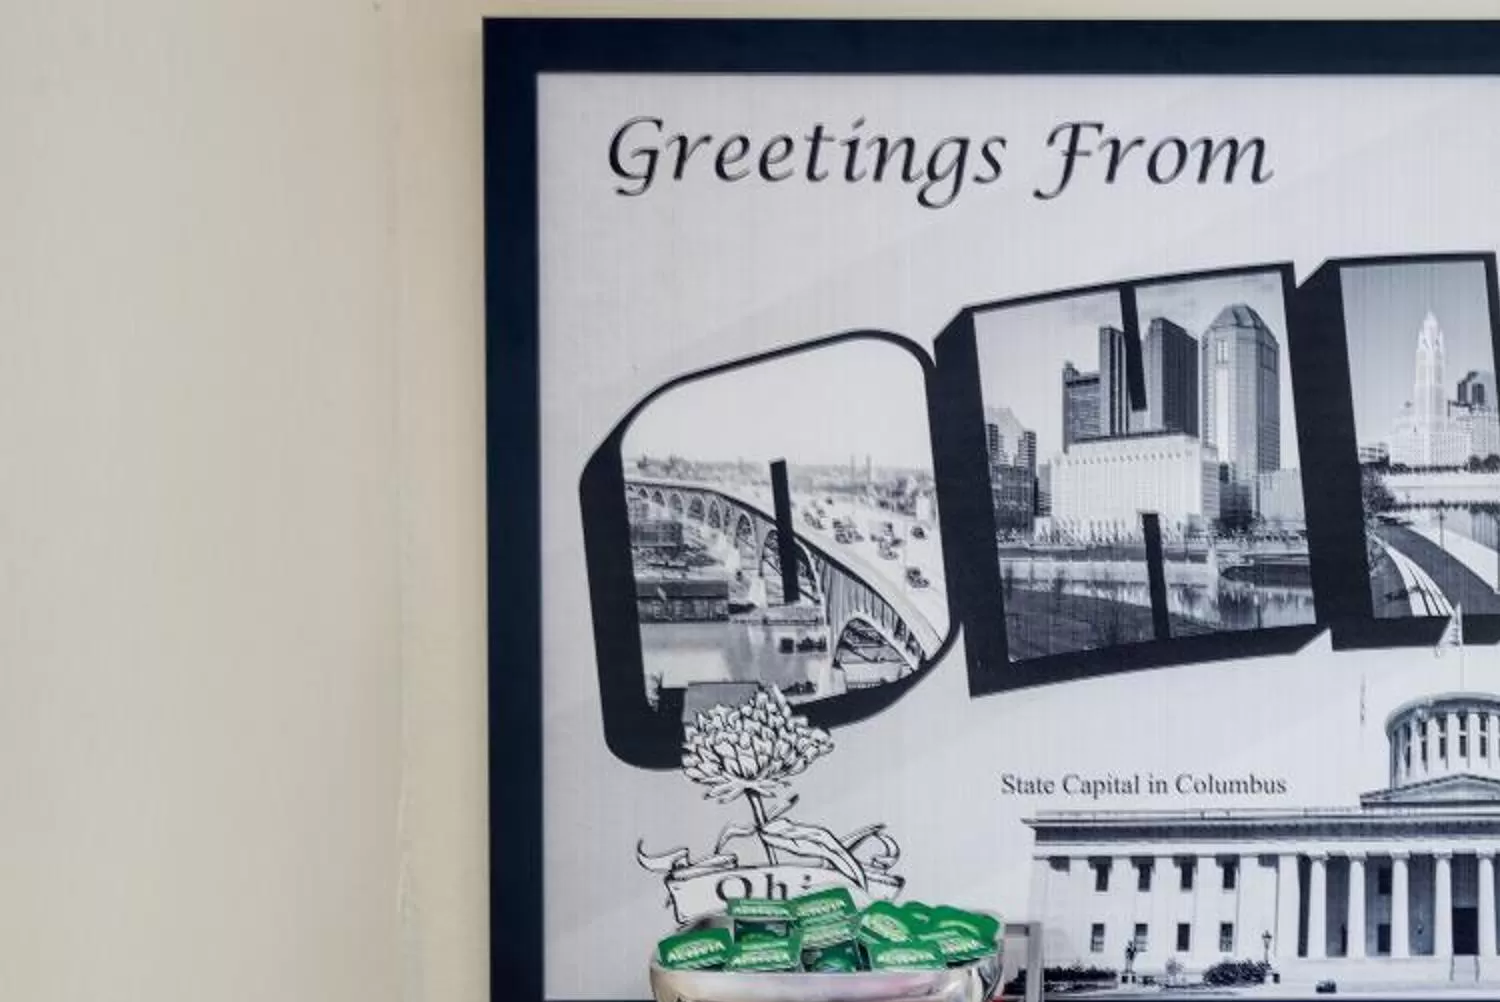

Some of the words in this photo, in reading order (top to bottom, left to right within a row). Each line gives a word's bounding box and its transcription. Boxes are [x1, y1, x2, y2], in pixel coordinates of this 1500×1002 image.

[607, 116, 1007, 209] Greetings
[1033, 120, 1274, 201] From
[1000, 773, 1055, 795] State
[1062, 772, 1140, 800] Capital
[1148, 772, 1169, 795] in
[1175, 772, 1288, 795] Columbus
